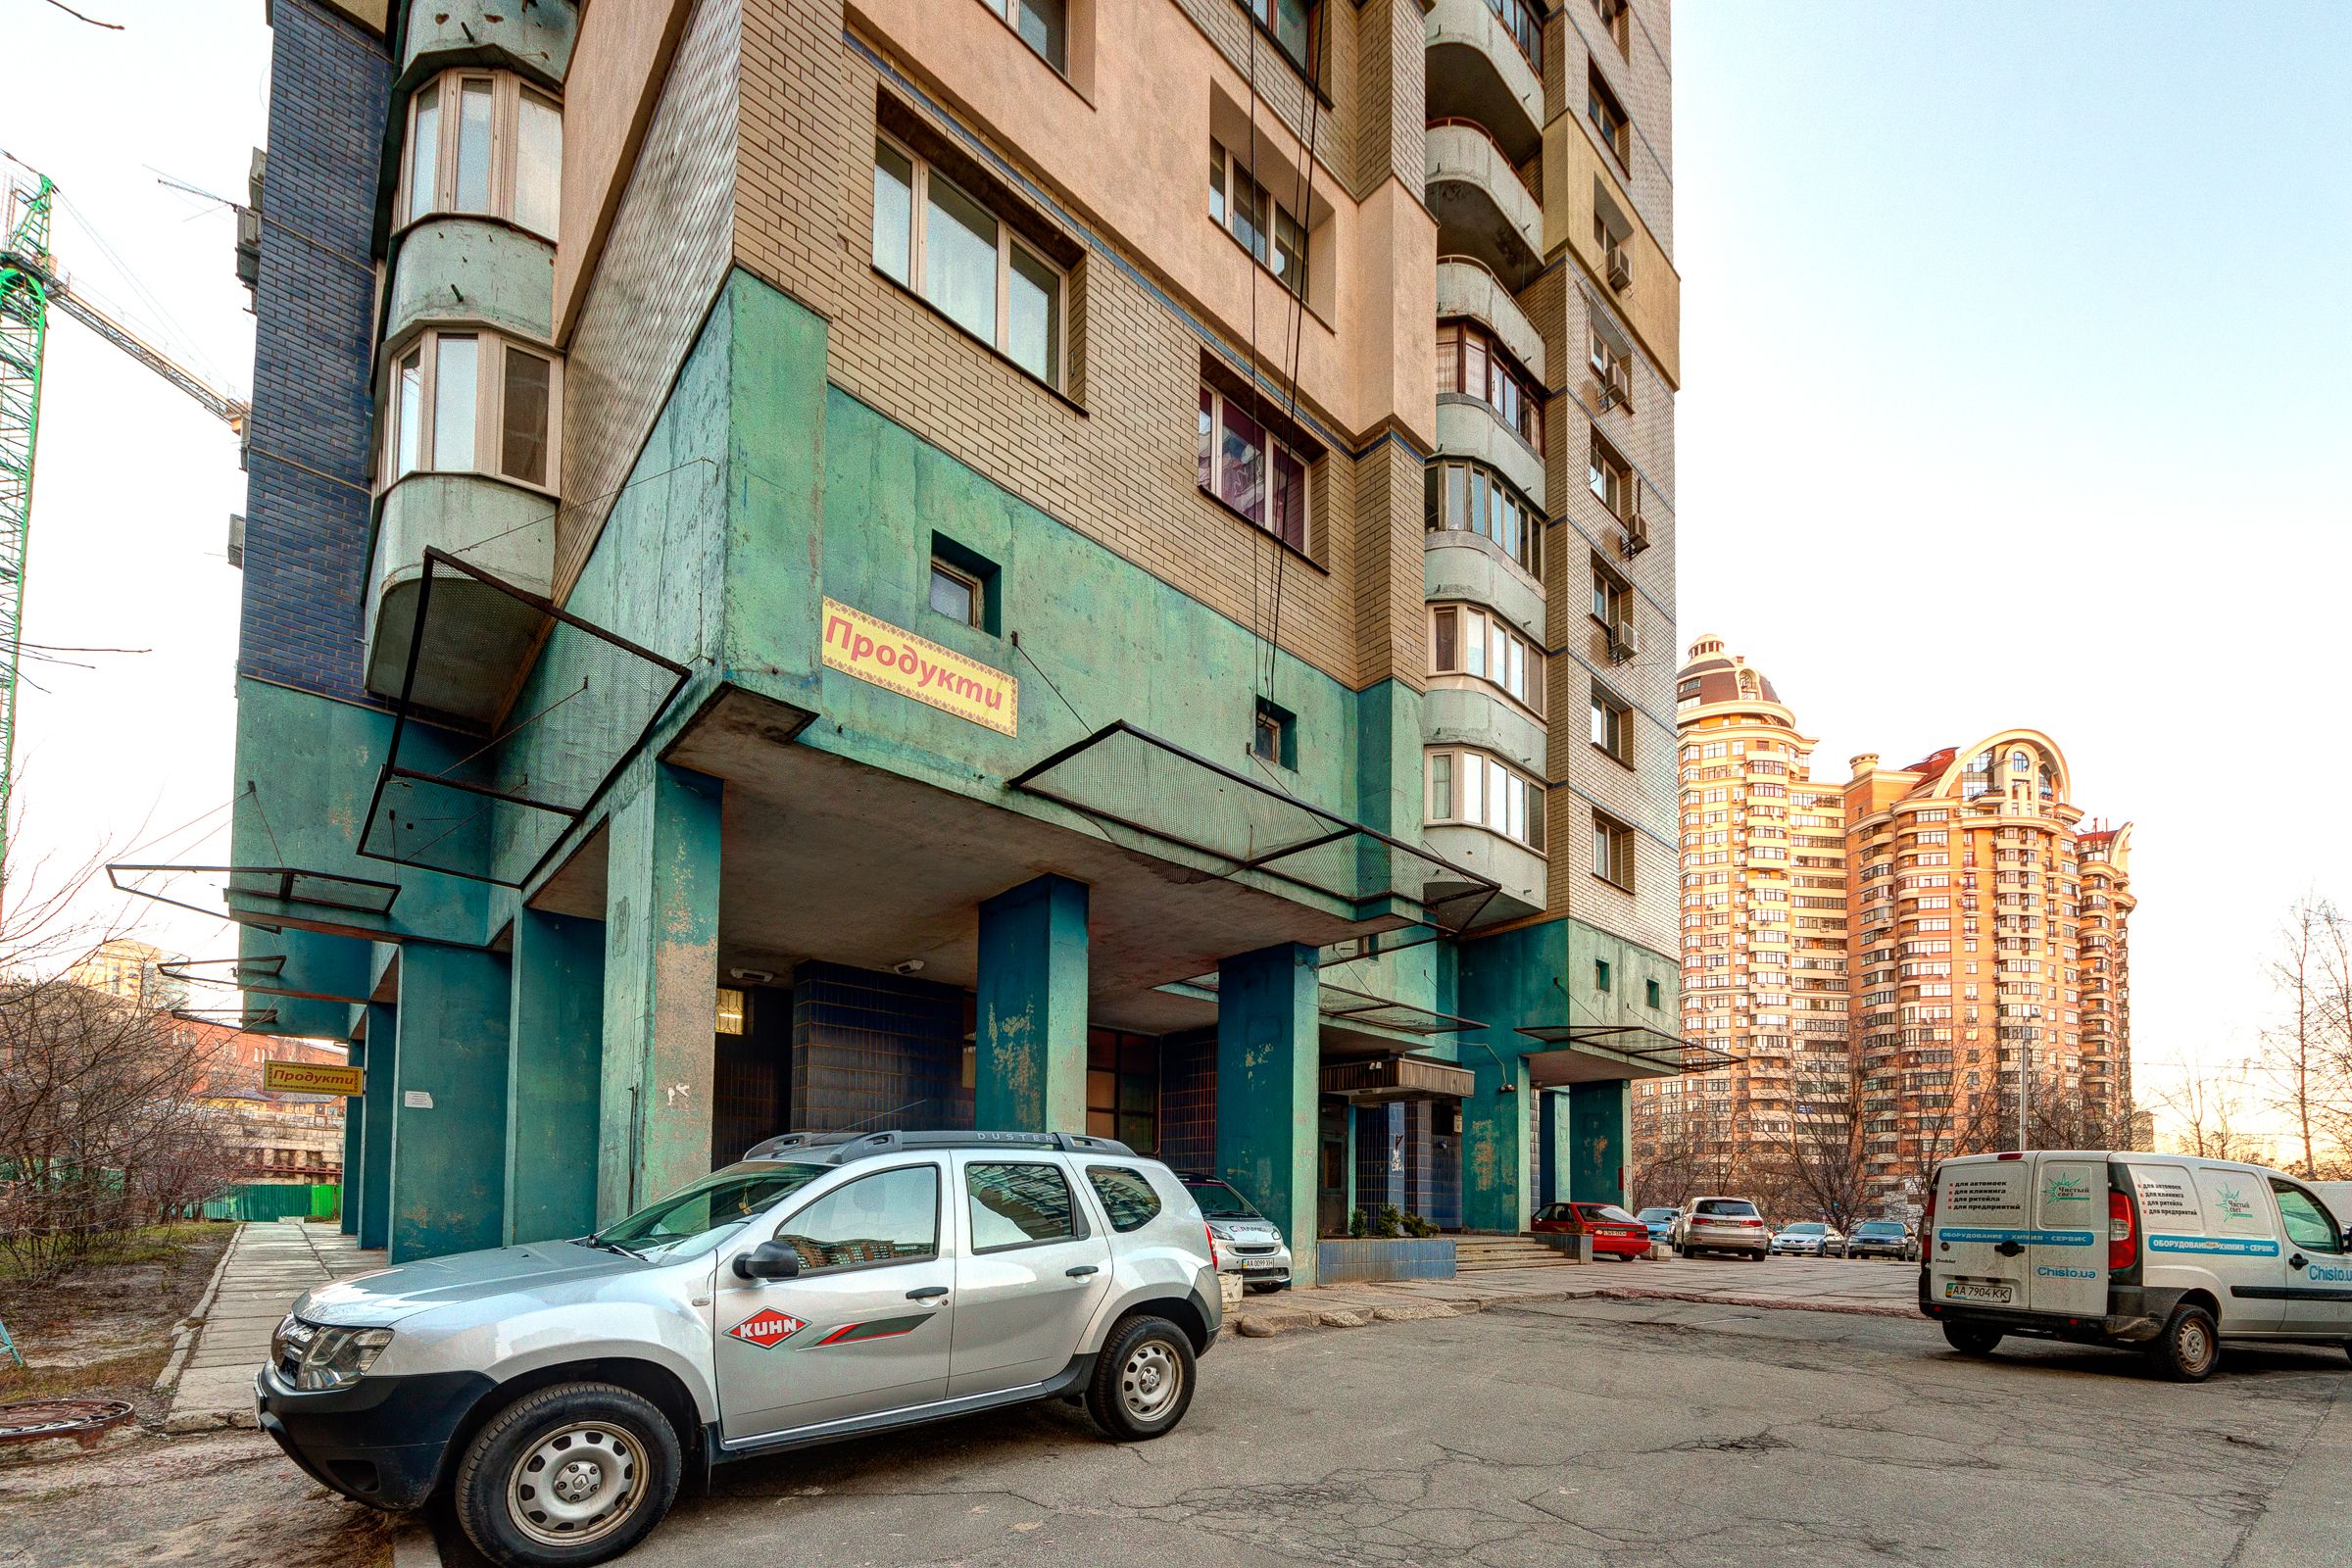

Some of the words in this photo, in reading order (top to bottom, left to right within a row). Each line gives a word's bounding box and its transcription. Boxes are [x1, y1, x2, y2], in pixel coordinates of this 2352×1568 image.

[825, 615, 1002, 710] Продукти
[273, 1070, 354, 1085] Продукти
[977, 1133, 1054, 1142] DUSTER
[2037, 1266, 2096, 1279] Chisto.ua
[1953, 1286, 1966, 1295] AA
[1968, 1287, 1991, 1298] 7904
[1992, 1289, 2009, 1299] KK
[740, 1319, 797, 1338] KUHN
